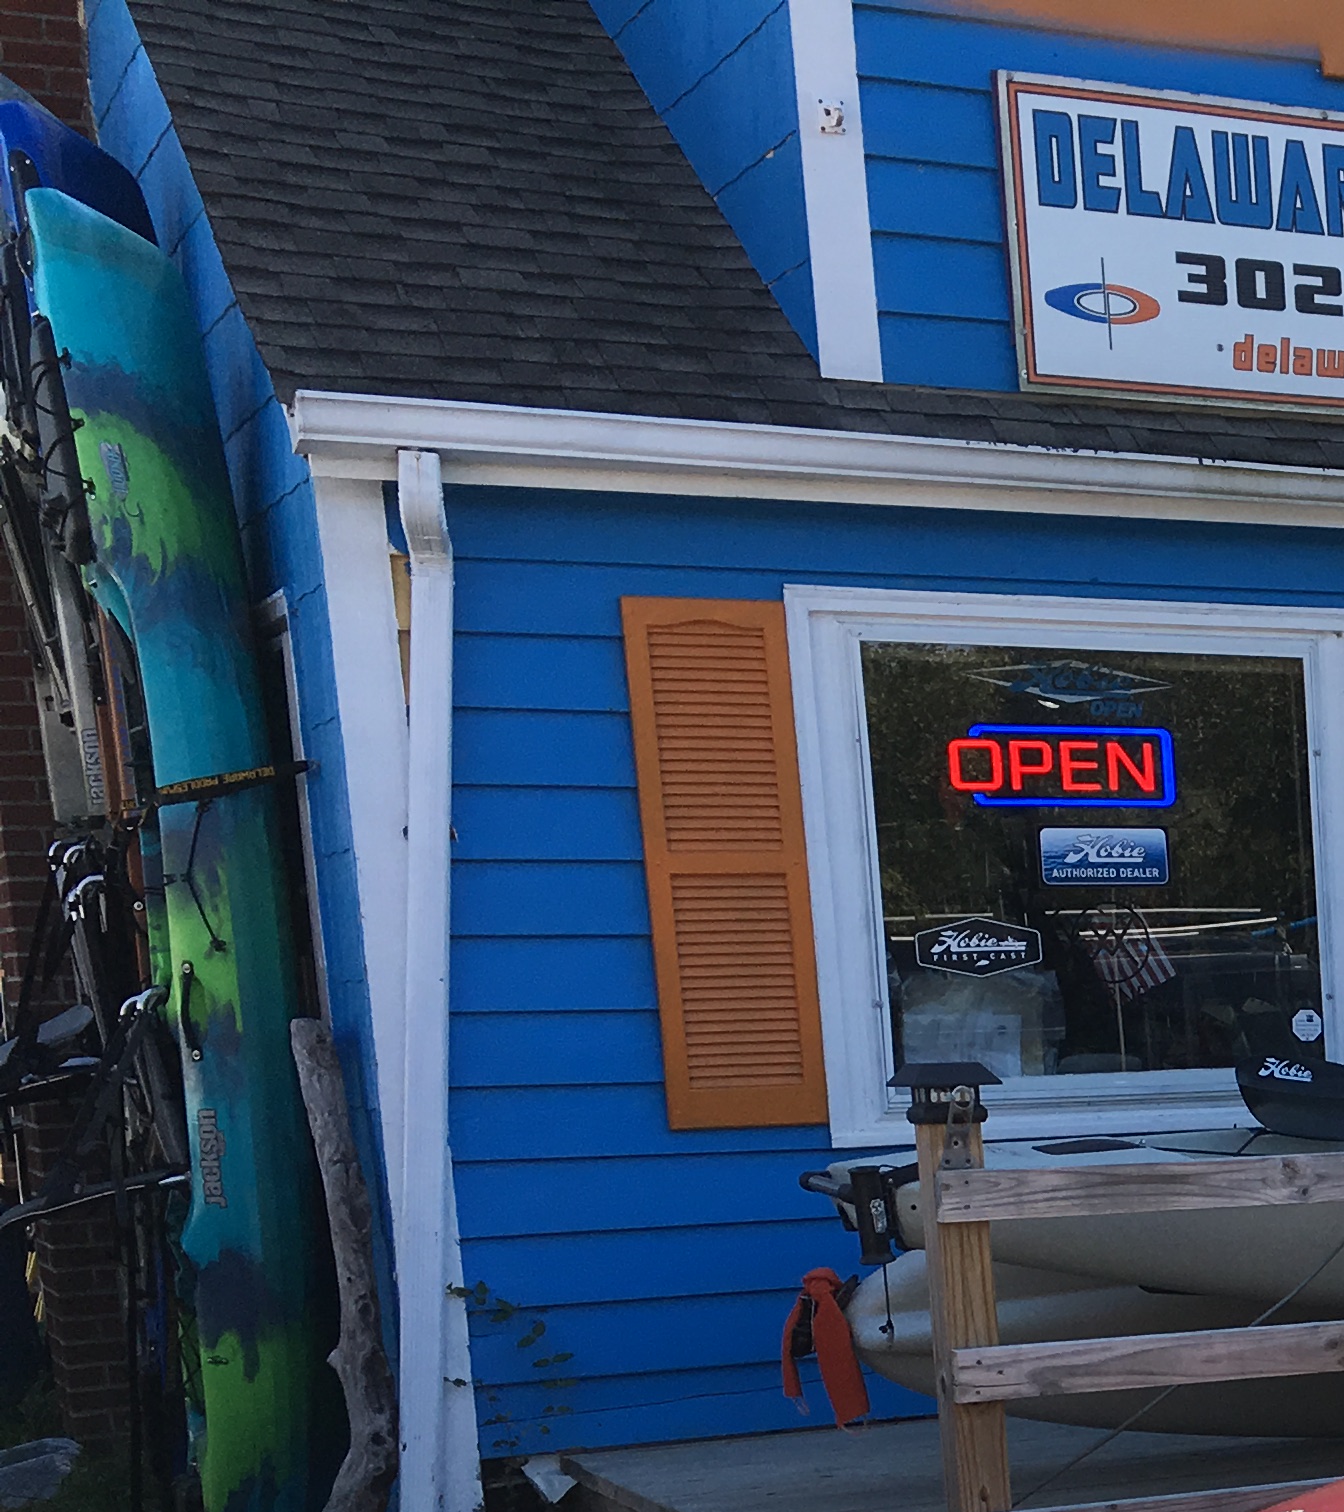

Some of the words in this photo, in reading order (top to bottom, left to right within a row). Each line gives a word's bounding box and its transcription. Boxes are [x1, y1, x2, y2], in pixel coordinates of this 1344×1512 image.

[1090, 701, 1143, 718] OPEN
[948, 738, 1156, 793] OPEN
[1064, 834, 1146, 864] Hobie
[1051, 868, 1117, 879] AUTHORIZED
[1119, 868, 1160, 878] DEALER
[930, 930, 1027, 953] Hobie
[933, 953, 978, 961] FIRST
[990, 952, 1027, 960] CAST
[1258, 1057, 1313, 1083] Hobie
